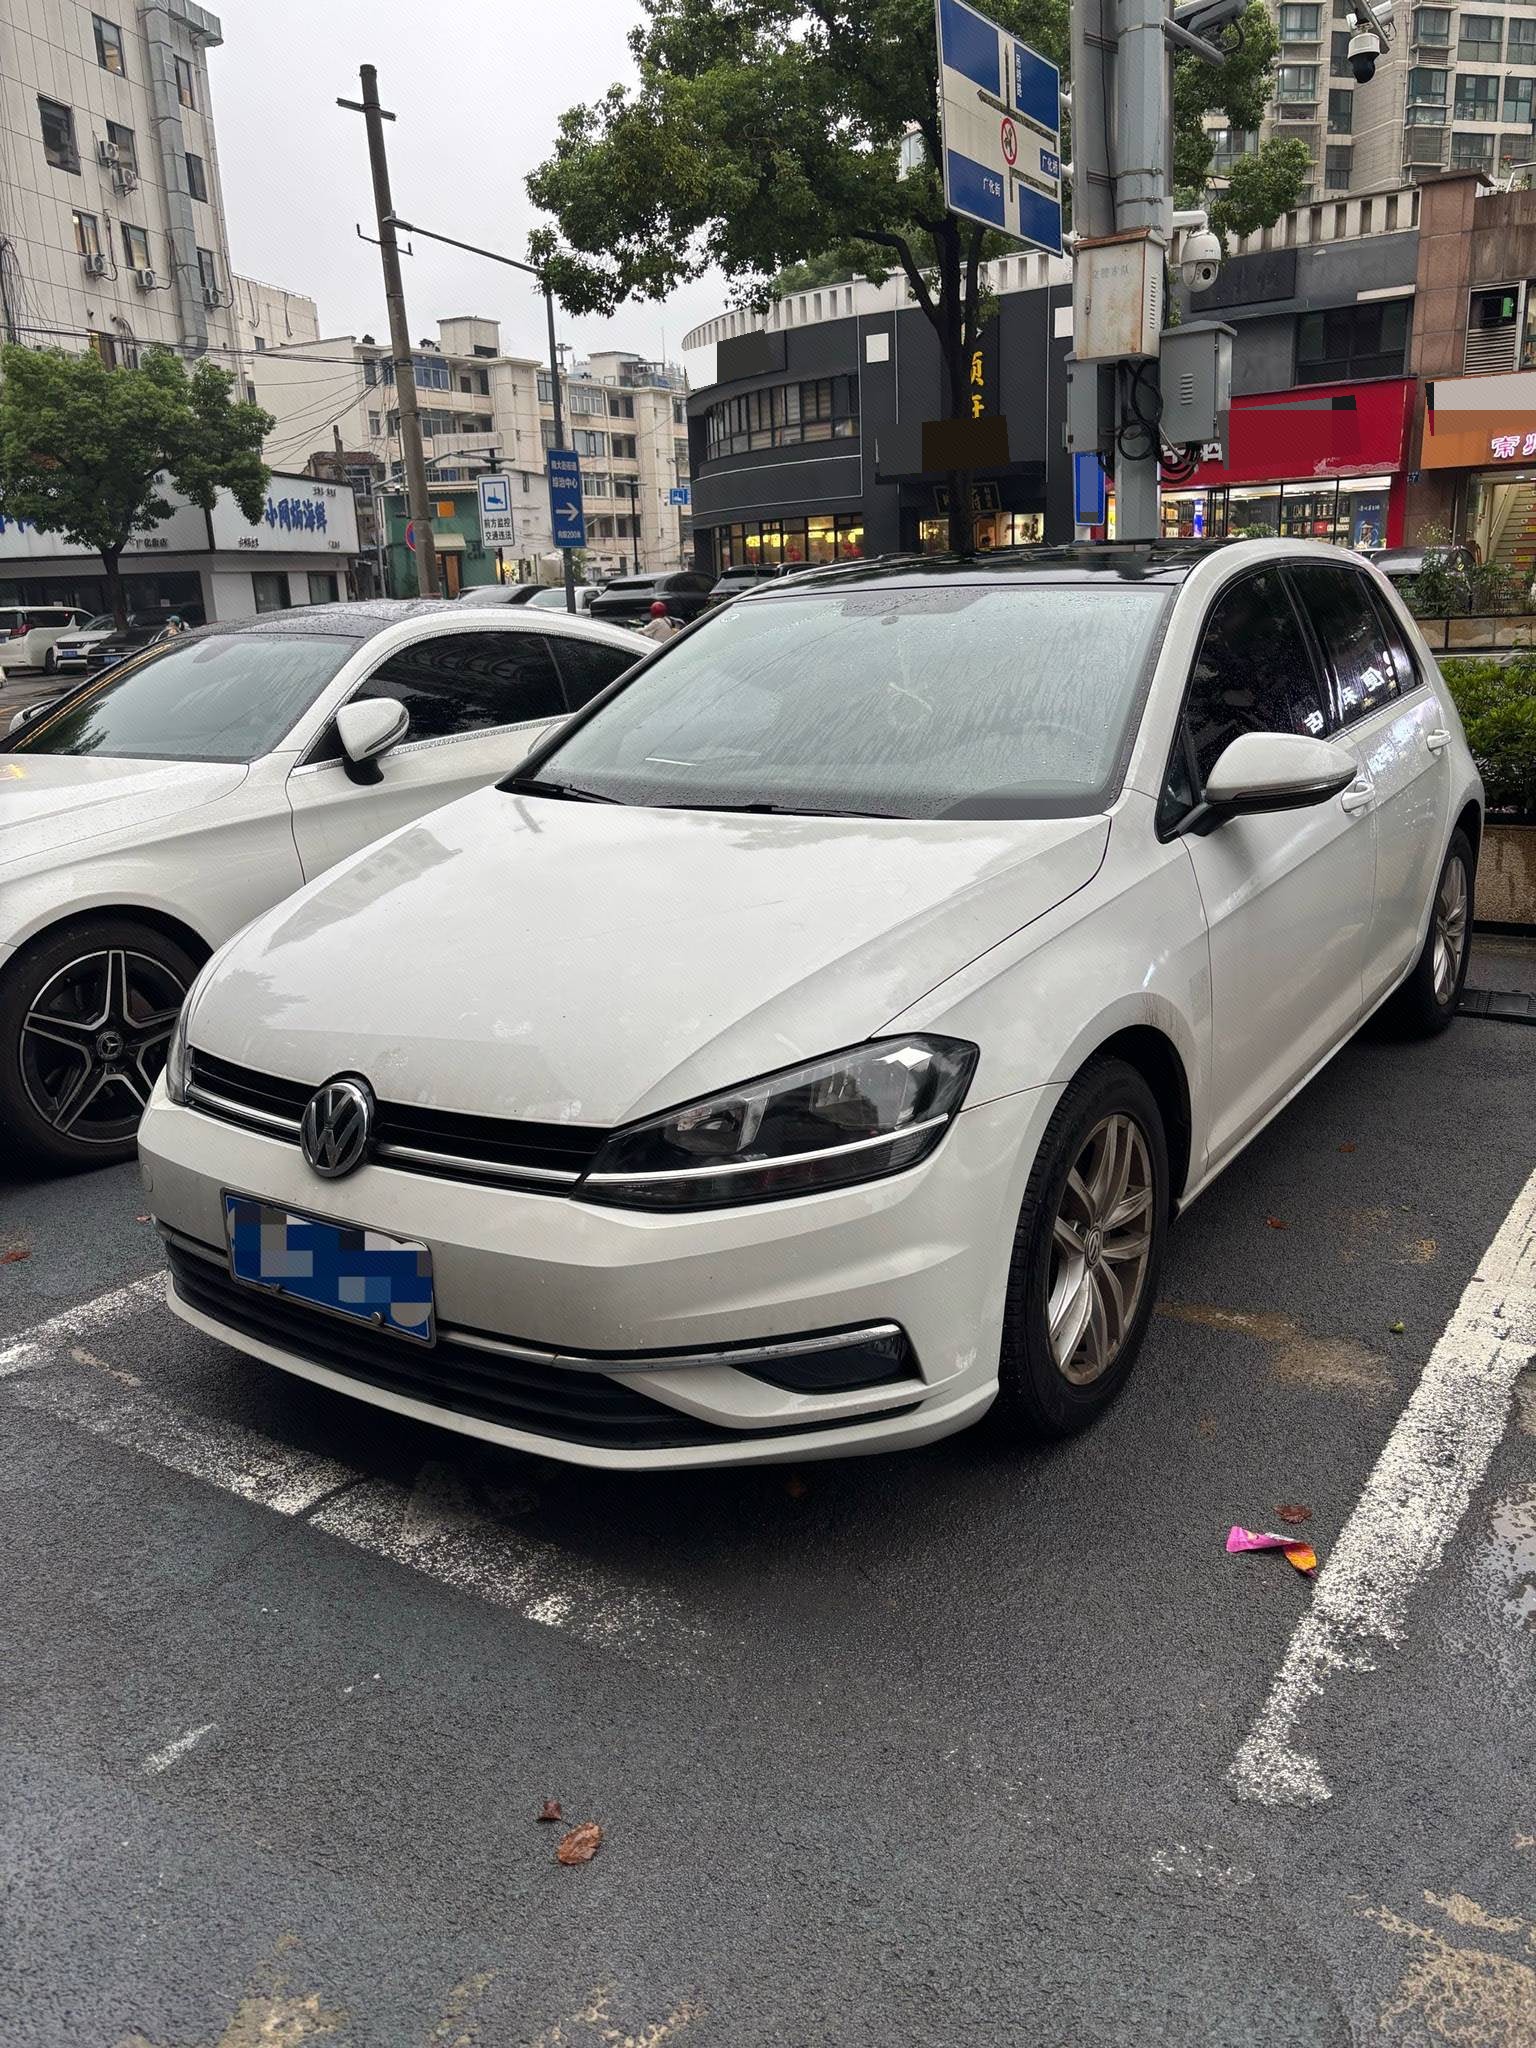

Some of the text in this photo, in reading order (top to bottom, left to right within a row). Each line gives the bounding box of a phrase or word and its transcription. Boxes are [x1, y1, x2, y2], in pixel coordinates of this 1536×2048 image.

[1042, 155, 1058, 174] 广化街
[983, 178, 1001, 198] 广化街
[552, 477, 578, 489] 综治中心
[484, 518, 511, 529] 前方监控
[485, 531, 512, 541] 交通违法
